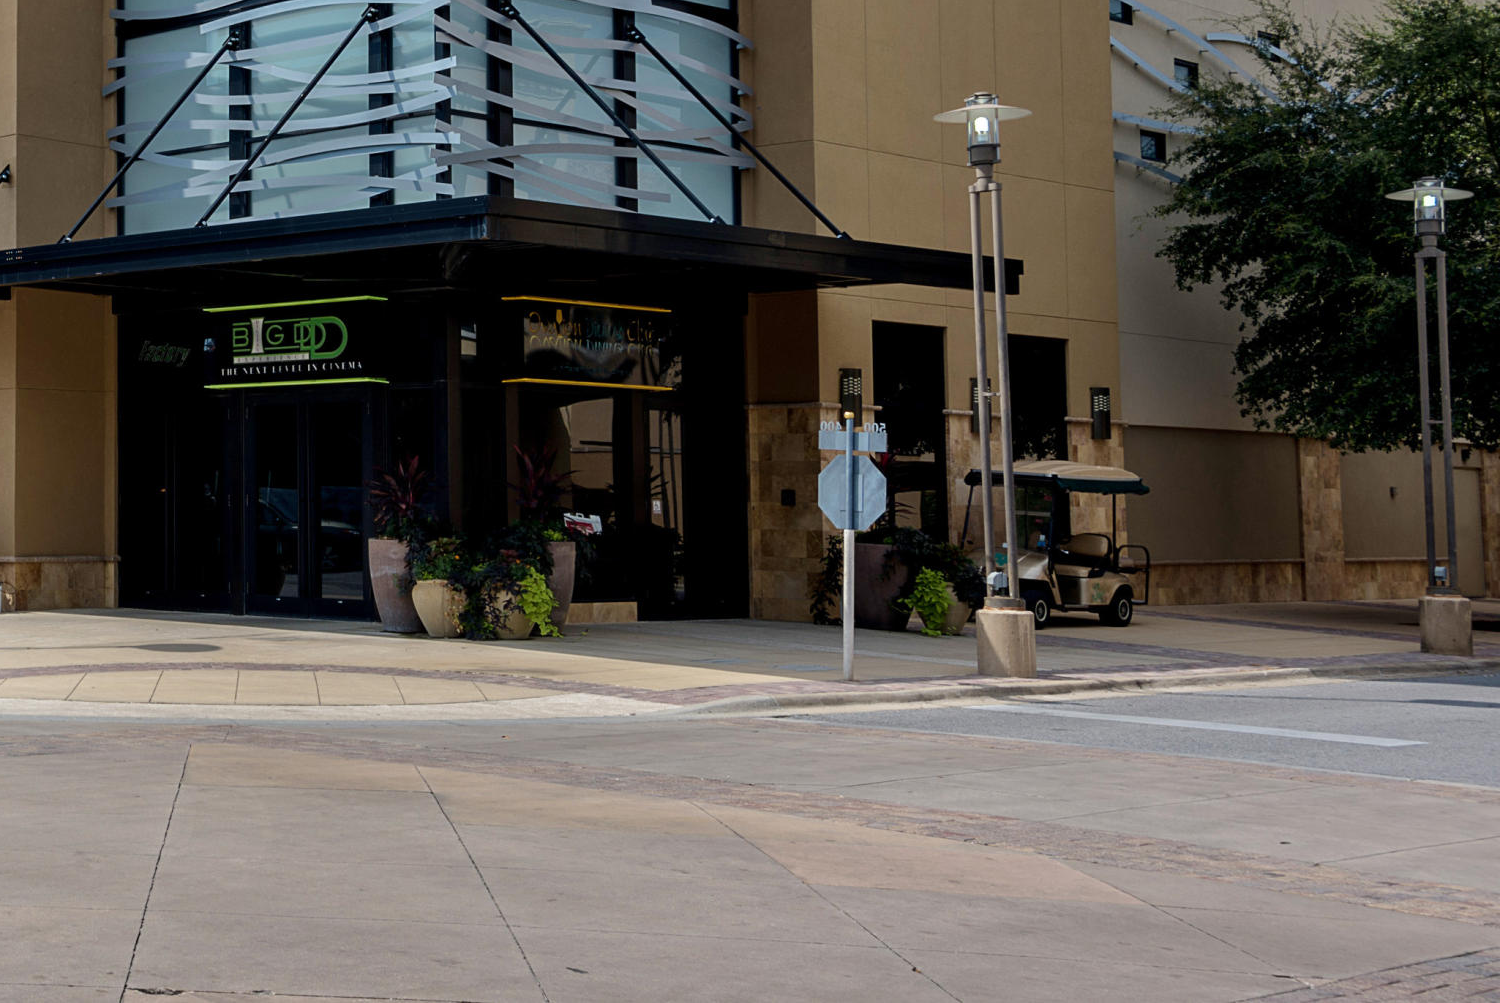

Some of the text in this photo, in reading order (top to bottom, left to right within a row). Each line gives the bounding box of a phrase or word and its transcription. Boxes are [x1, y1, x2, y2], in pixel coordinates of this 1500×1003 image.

[232, 317, 284, 354] BIG
[221, 361, 362, 377] THE NEXT LEVEL IN CINEMA
